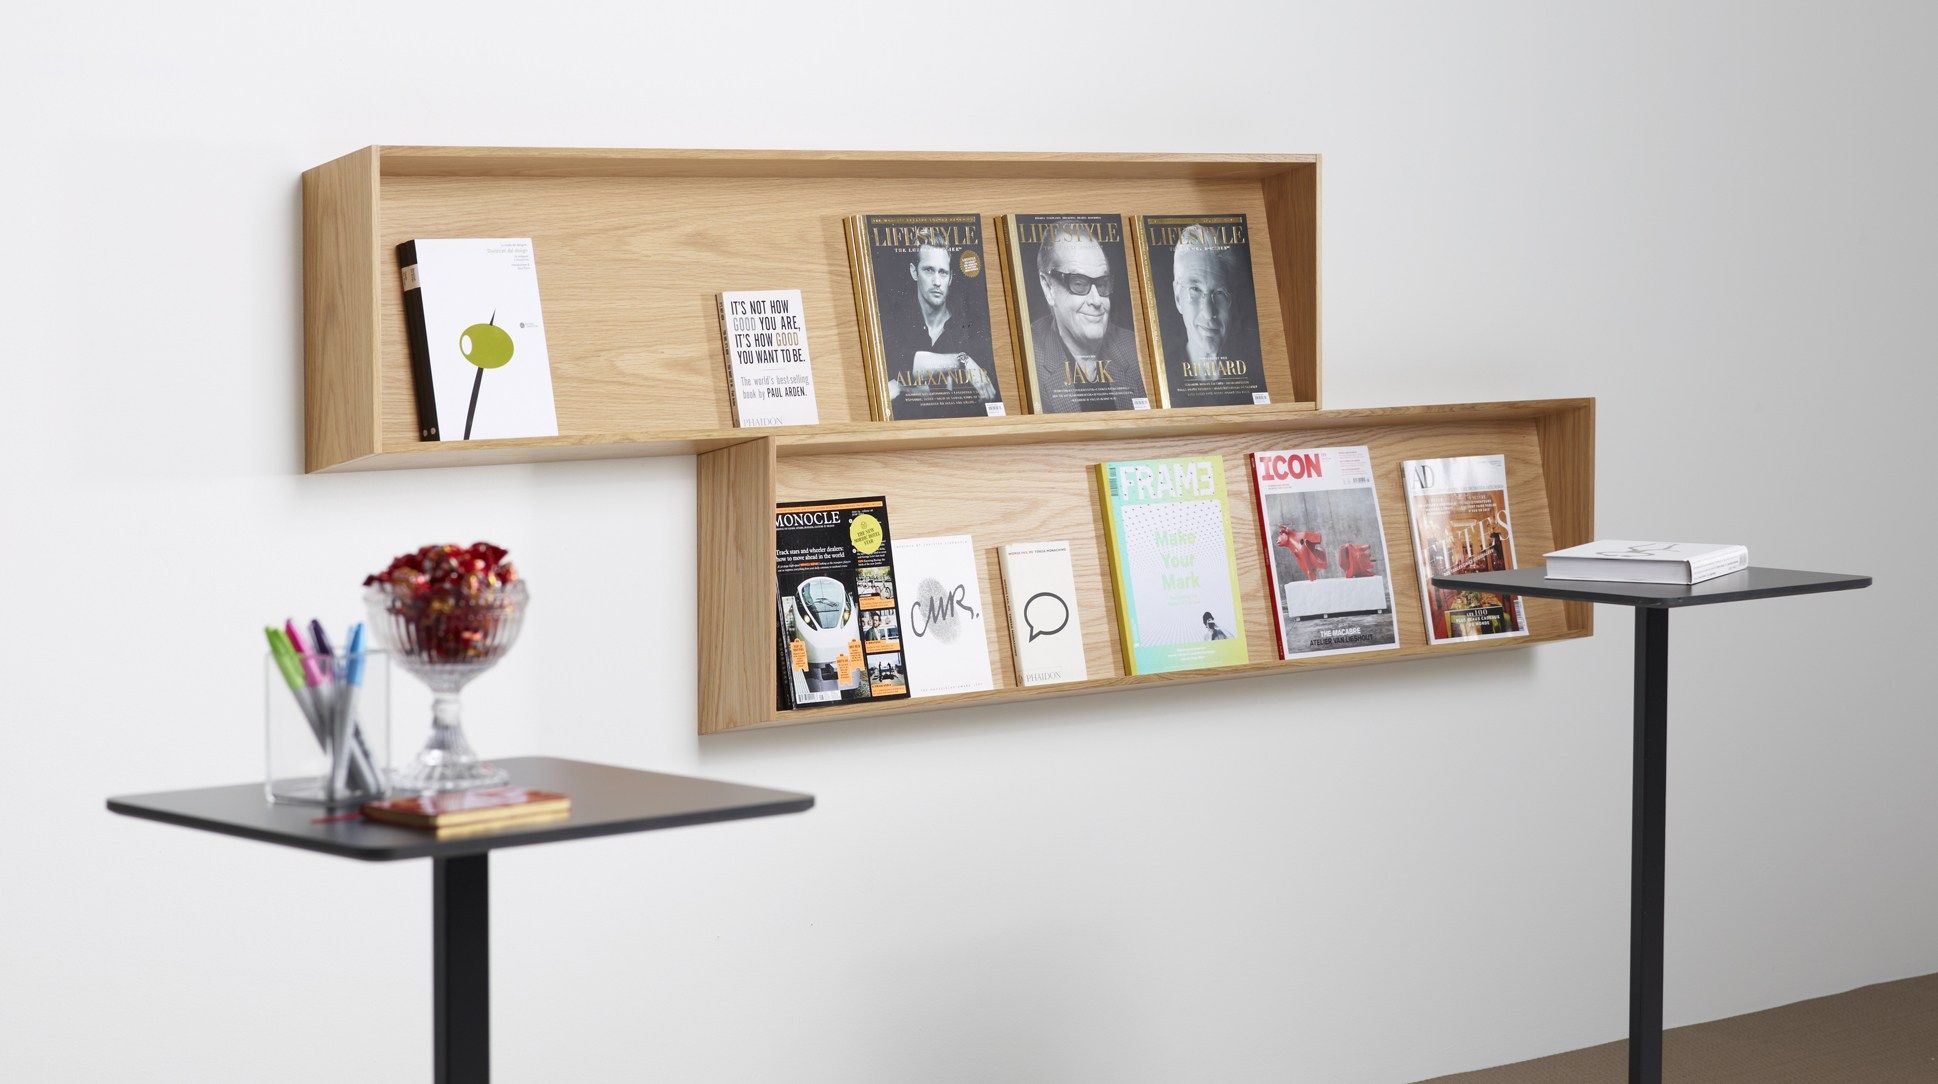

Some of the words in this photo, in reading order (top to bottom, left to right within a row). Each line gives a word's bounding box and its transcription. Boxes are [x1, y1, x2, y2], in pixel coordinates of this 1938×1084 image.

[872, 226, 979, 247] LIFESTYLE
[1018, 222, 1120, 243] LIFESTYLE
[730, 300, 747, 315] IT'S
[749, 300, 766, 315] NOT
[769, 299, 789, 314] HOW
[732, 317, 757, 332] GOOD
[758, 316, 777, 331] YOU
[780, 315, 801, 332] ARE,
[734, 333, 752, 348] IT'S
[753, 332, 773, 348] HOW
[775, 332, 799, 347] GOOD
[736, 350, 754, 365] YOU
[755, 349, 779, 364] WANT
[780, 348, 792, 363] TO
[792, 348, 806, 363] BE.
[740, 376, 752, 386] The
[1063, 359, 1116, 386] JACK
[766, 387, 783, 398] PAUL
[784, 386, 808, 397] ARDEN.
[1259, 453, 1323, 481] ICON
[1410, 465, 1435, 489] AD
[776, 511, 841, 527] MONOCLE
[1152, 529, 1197, 548] Make
[1160, 553, 1195, 569] Your
[1160, 571, 1200, 591] Mark
[1320, 630, 1332, 638] THE
[1332, 626, 1362, 637] MACABRE
[1332, 636, 1346, 645] VAN
